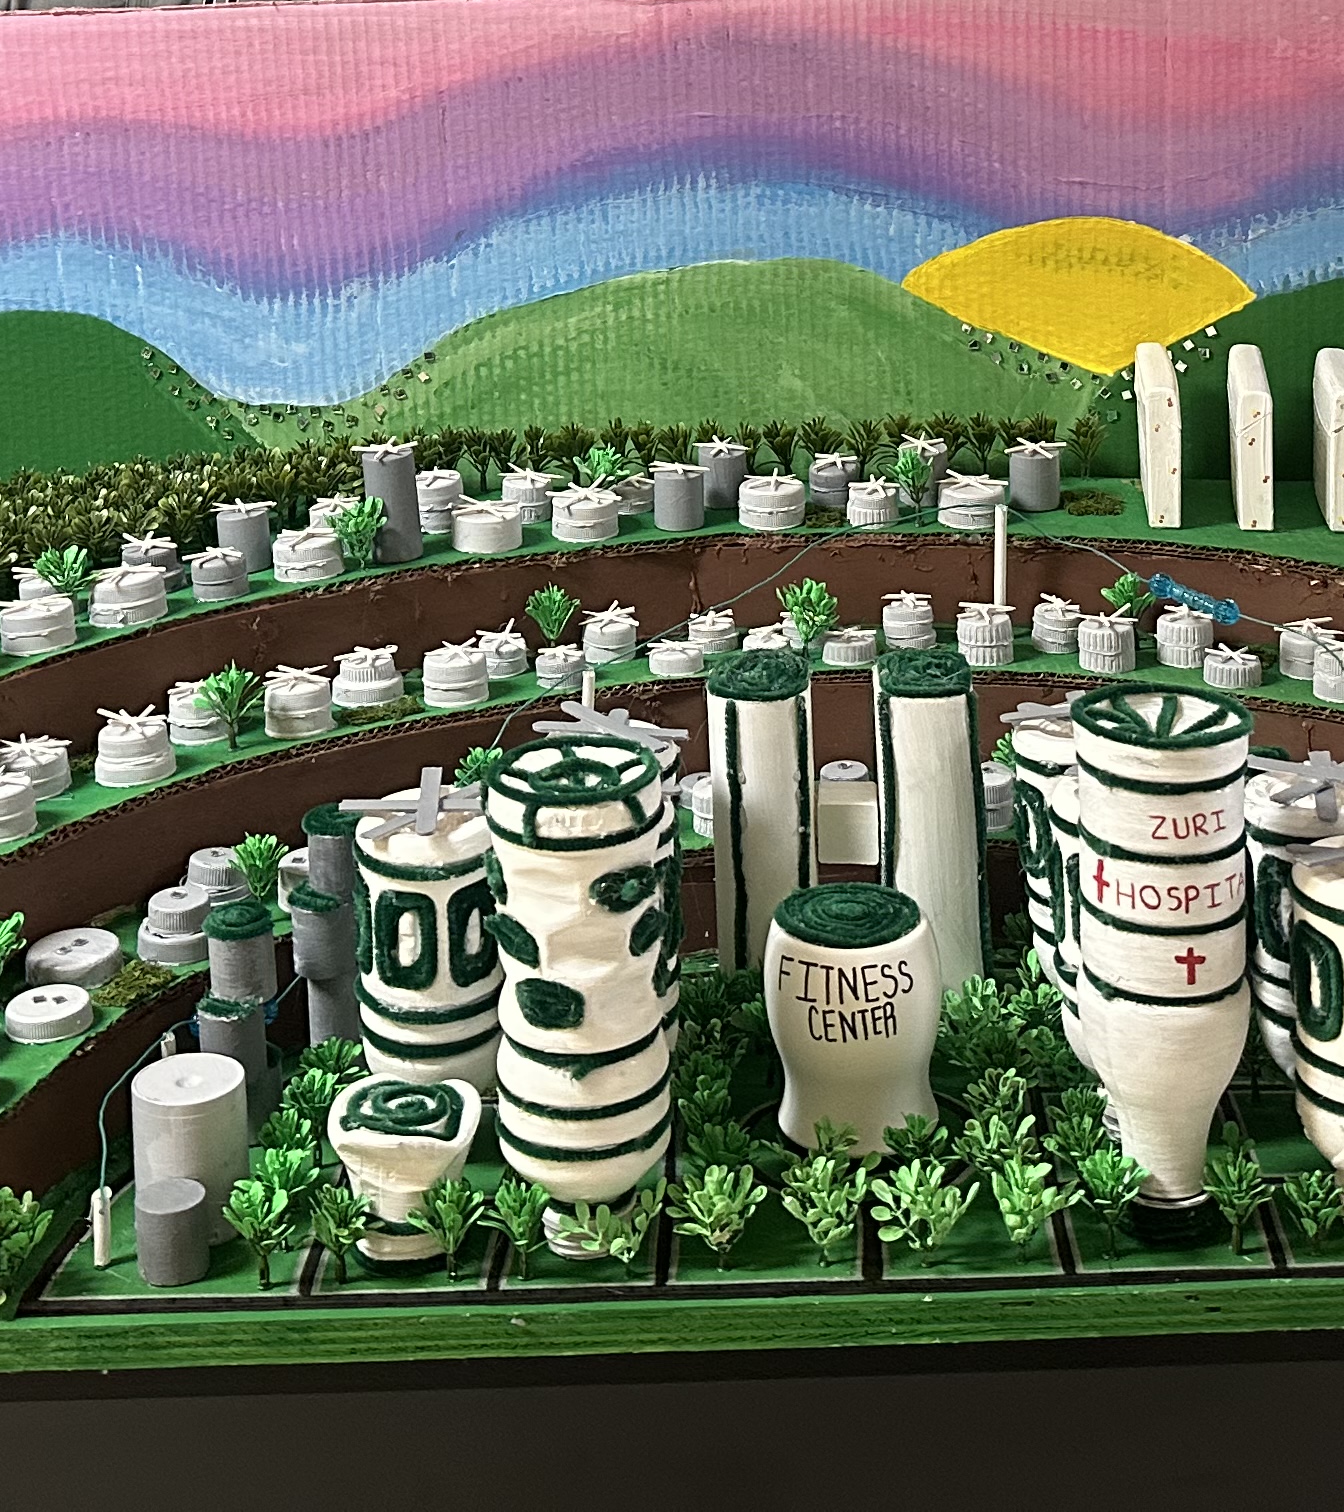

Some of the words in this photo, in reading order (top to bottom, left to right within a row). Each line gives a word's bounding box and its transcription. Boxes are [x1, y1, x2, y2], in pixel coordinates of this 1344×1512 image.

[1148, 809, 1227, 840] ZURI
[778, 954, 914, 1005] FITNESS
[808, 1001, 897, 1043] CENTER
